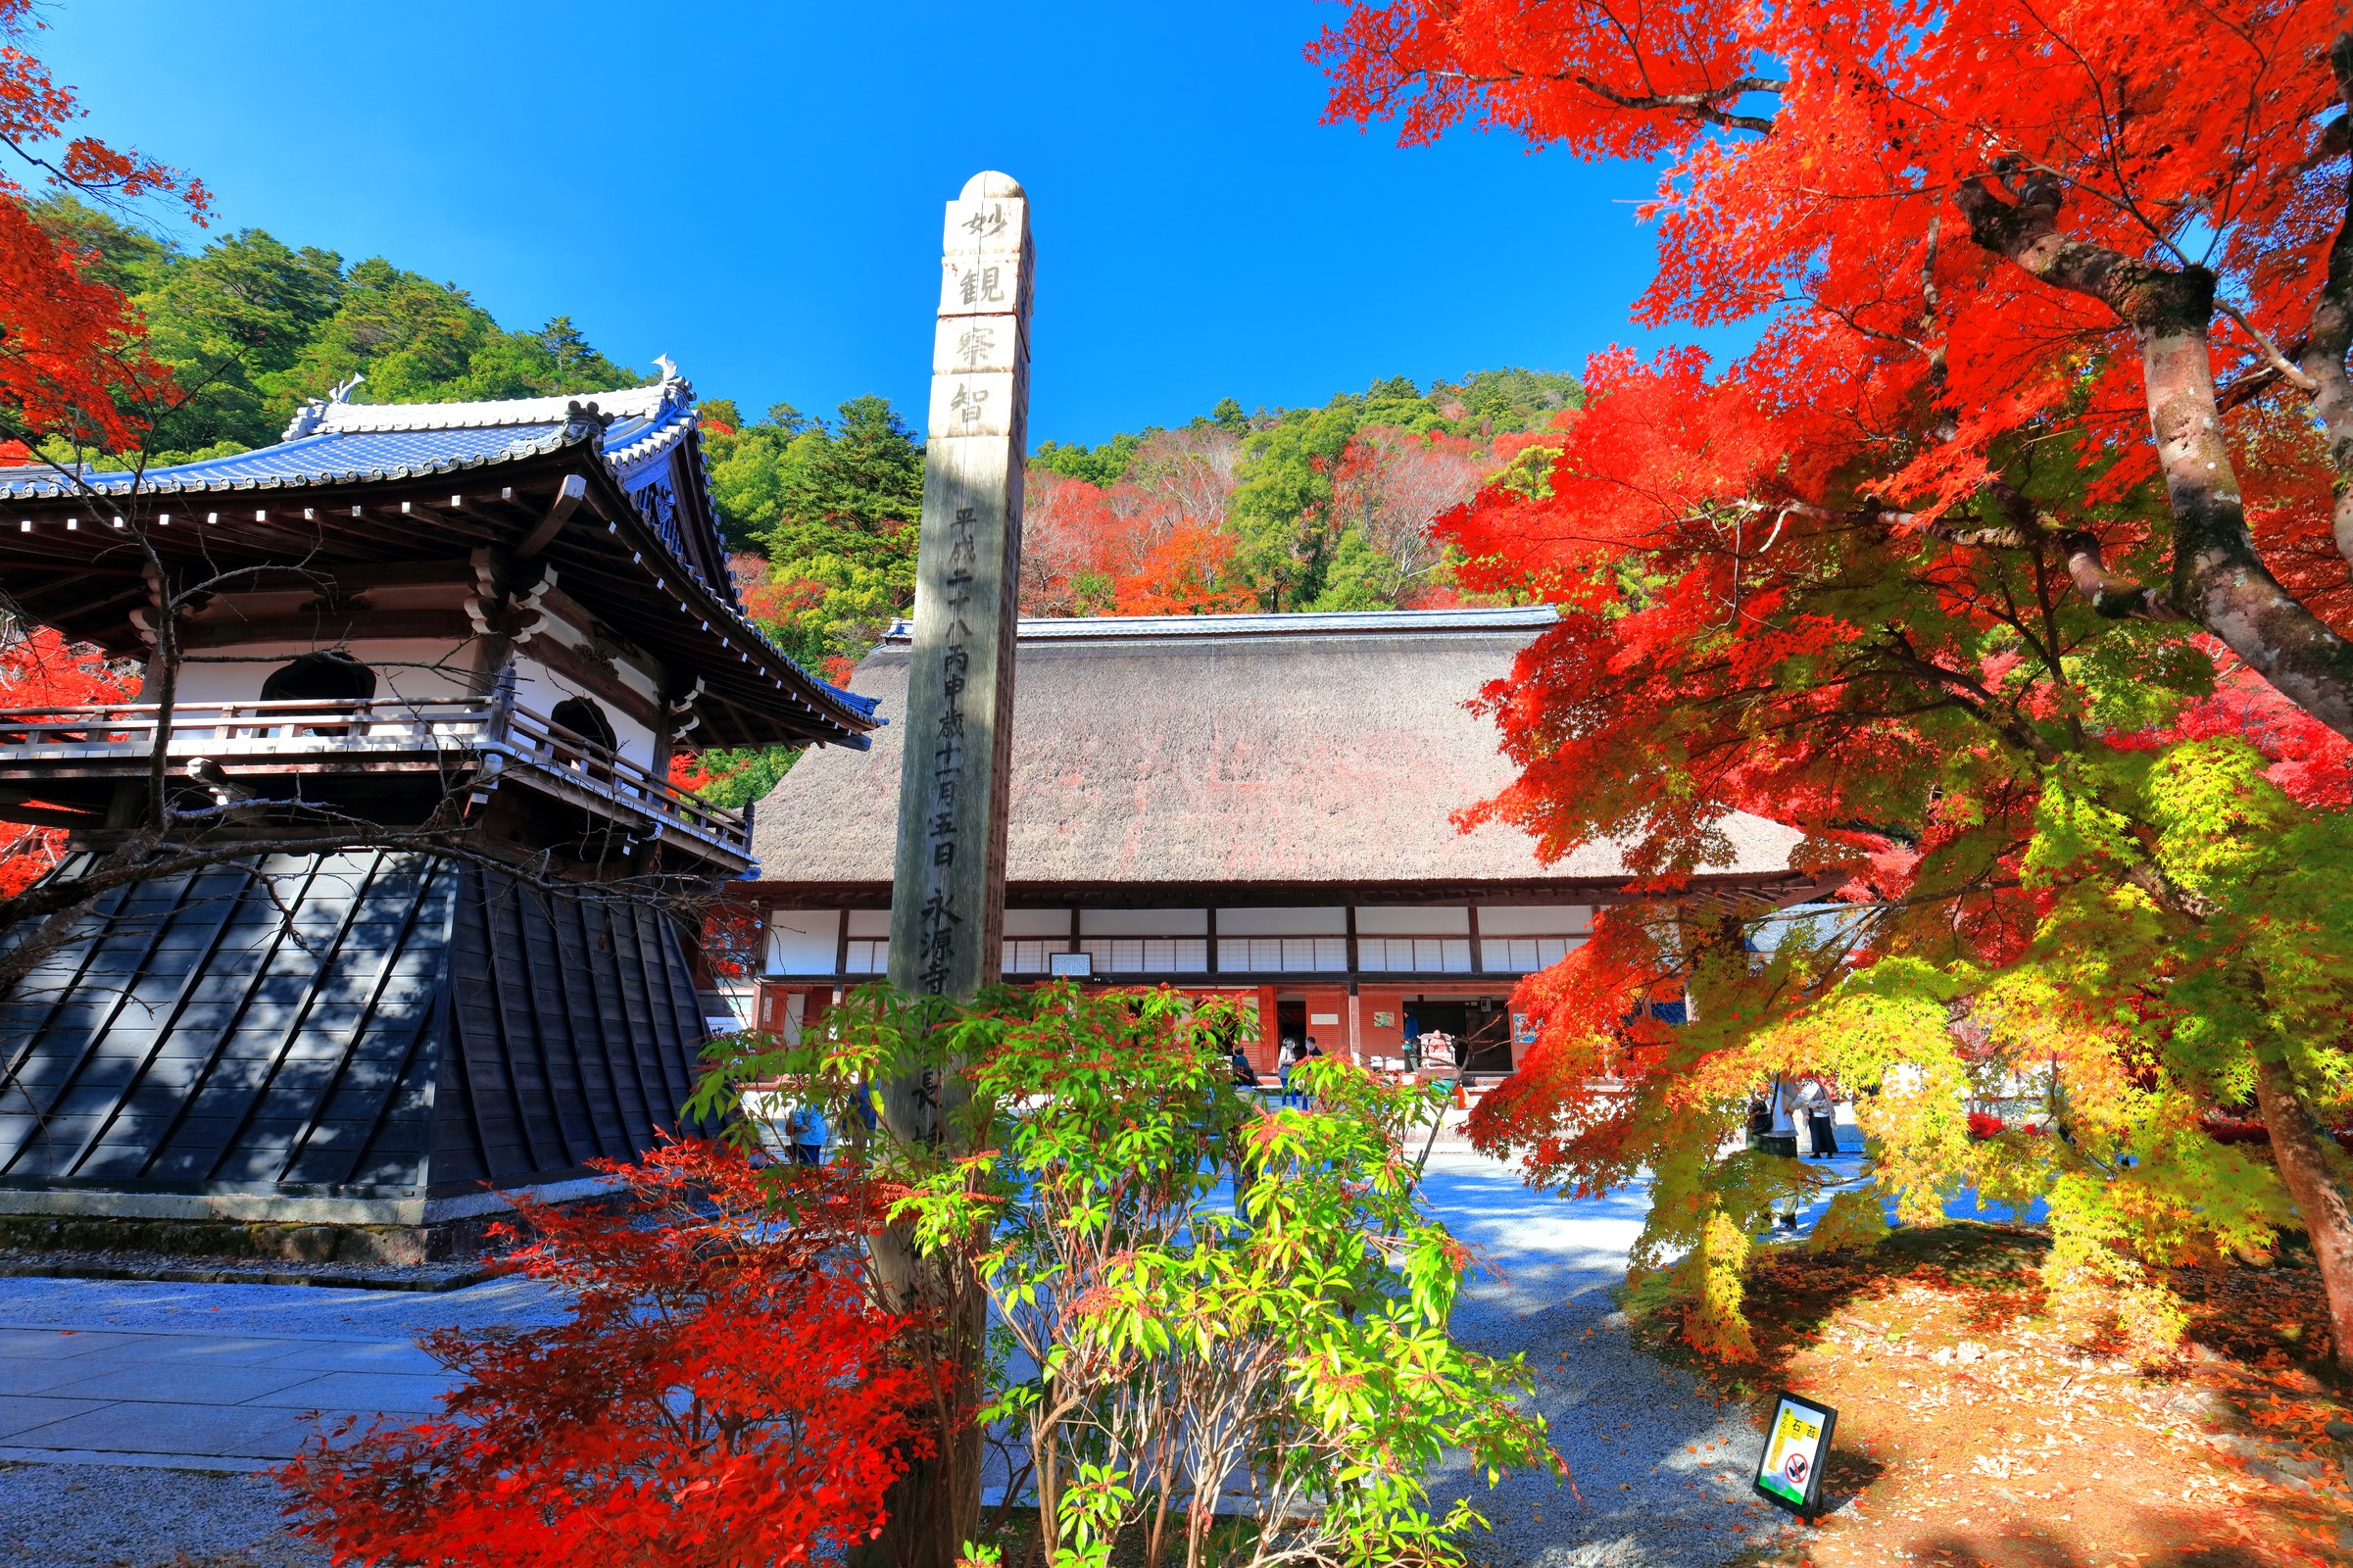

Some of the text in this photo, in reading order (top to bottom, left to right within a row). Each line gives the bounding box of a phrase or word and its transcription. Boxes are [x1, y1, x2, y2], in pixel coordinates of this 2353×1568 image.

[951, 203, 1007, 423] 妙観察智
[1807, 1425, 1817, 1439] 苔
